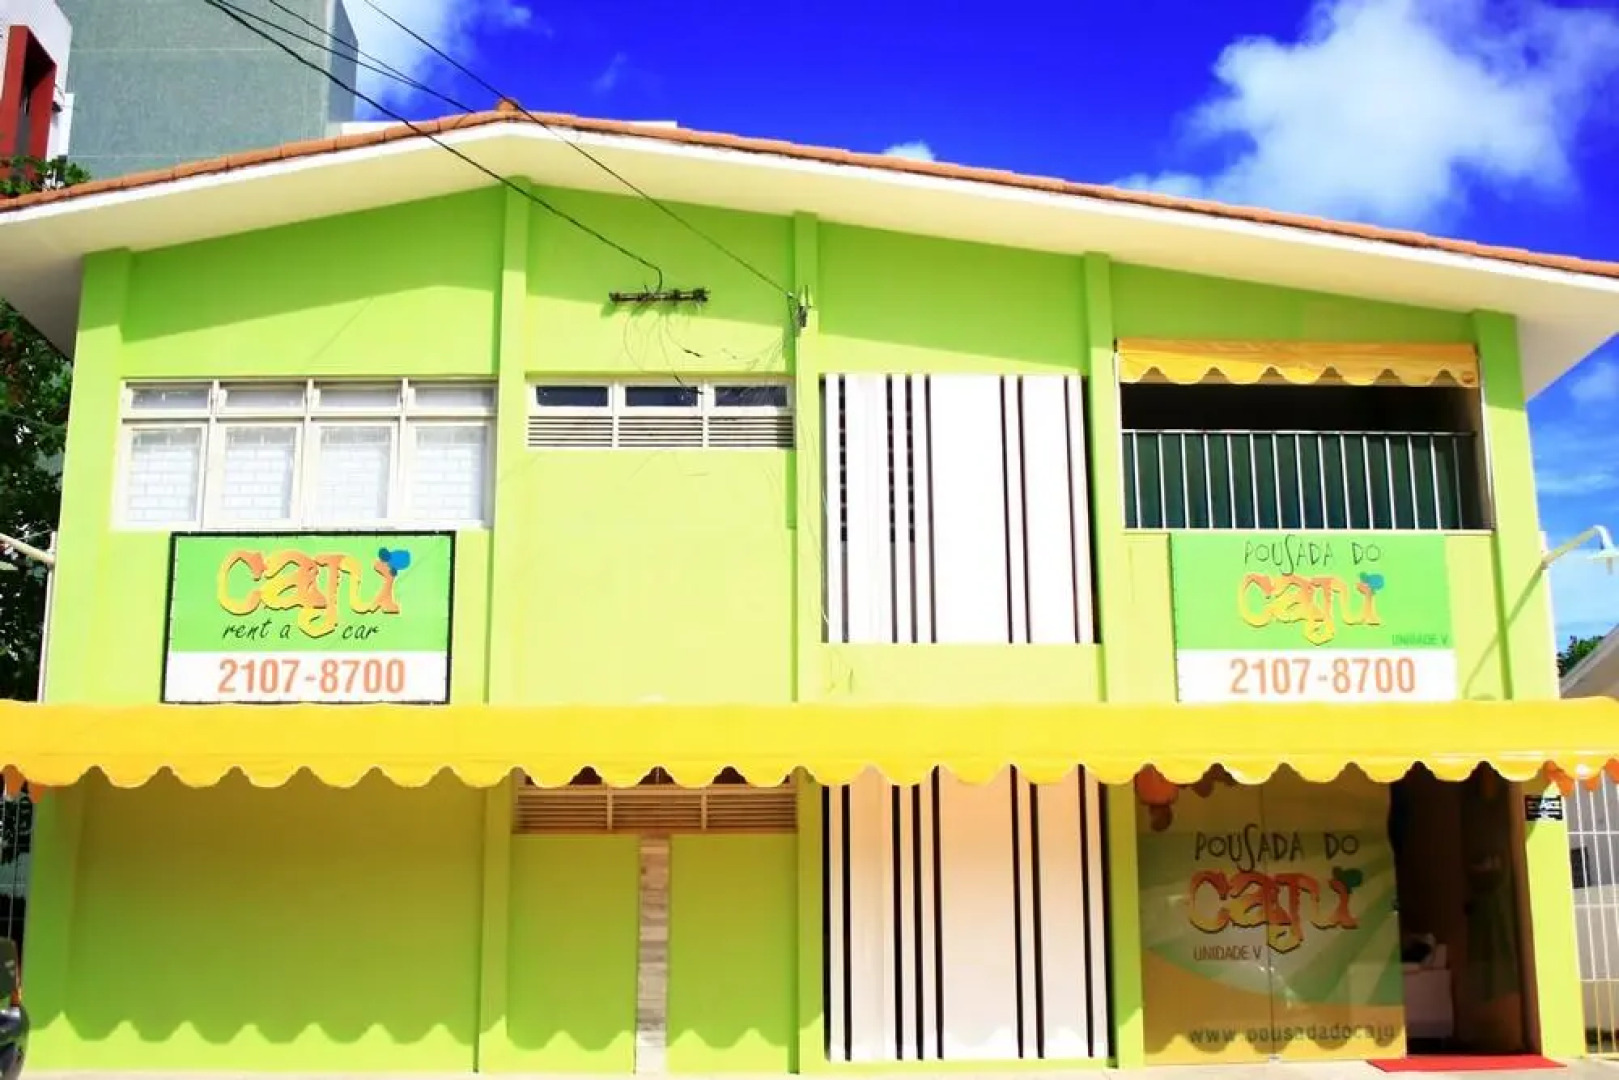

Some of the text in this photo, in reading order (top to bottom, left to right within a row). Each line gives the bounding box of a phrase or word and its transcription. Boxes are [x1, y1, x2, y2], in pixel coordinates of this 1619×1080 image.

[1244, 534, 1381, 576] POUSADA DO
[222, 619, 379, 639] rent a car
[218, 659, 406, 693] 2107-8700
[1230, 658, 1415, 693] 2107-8700
[1195, 824, 1360, 872] POUSADA DO
[1193, 945, 1262, 961] UNIDADE V
